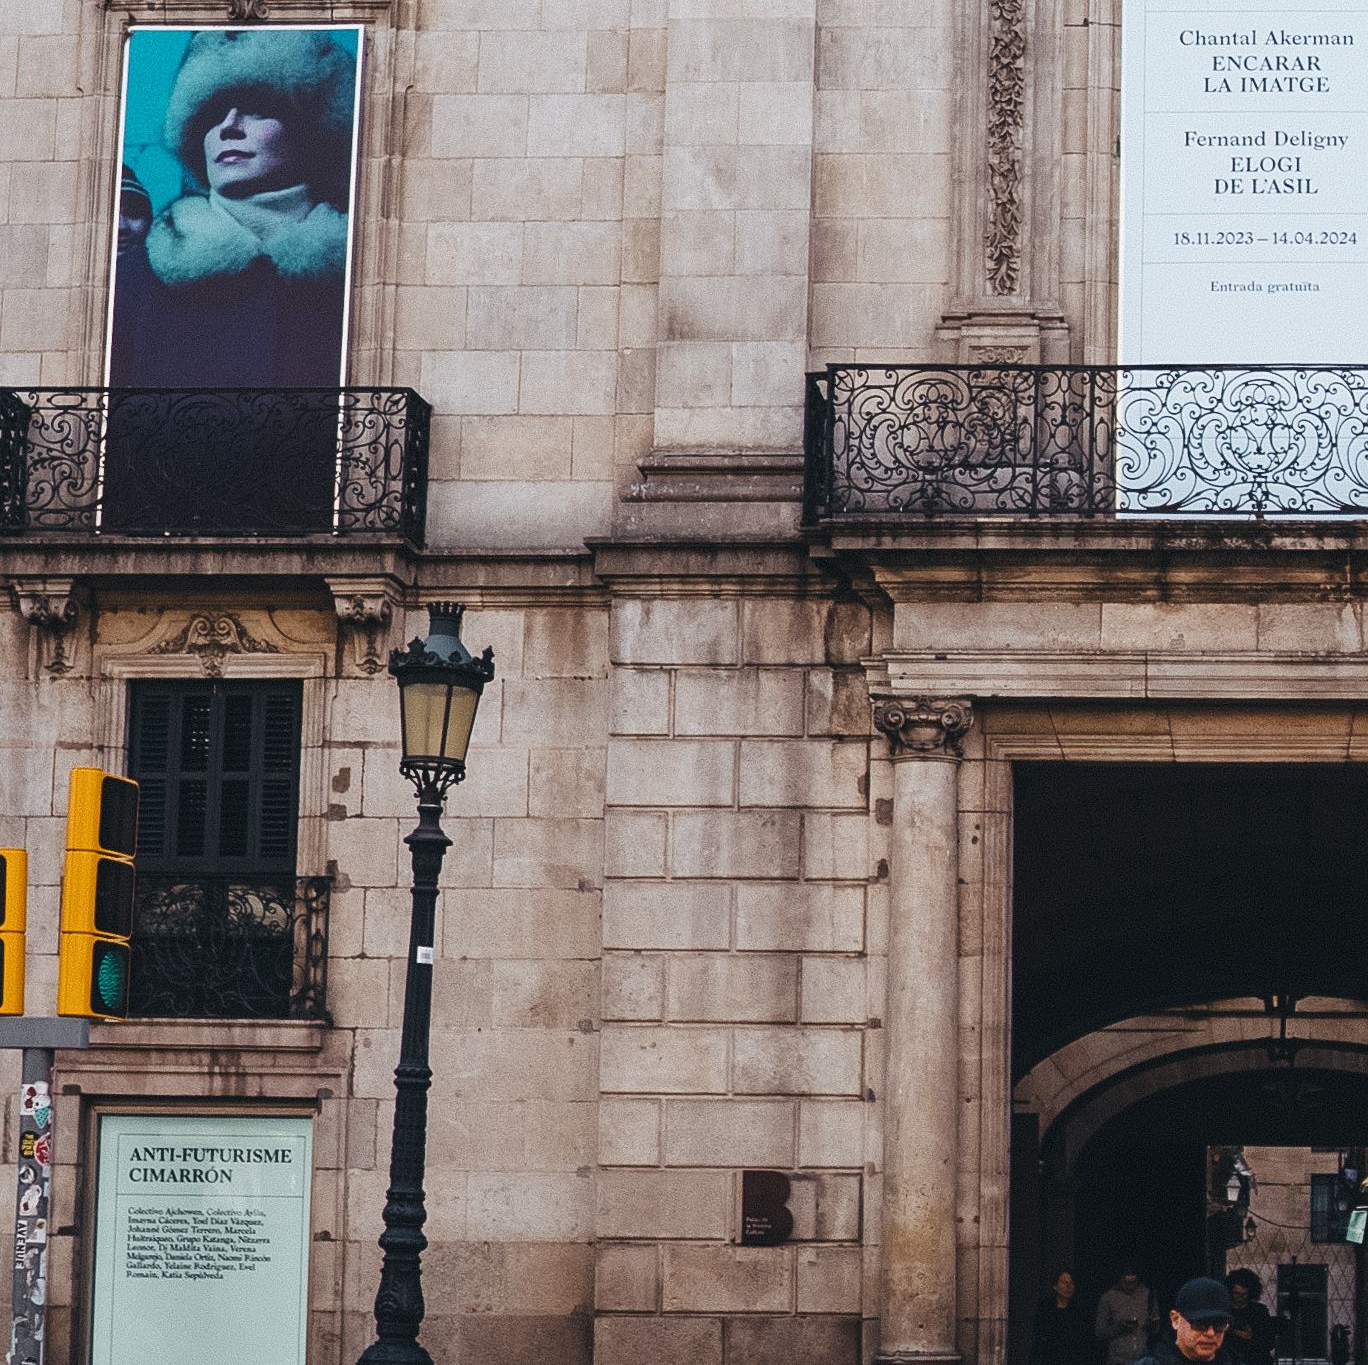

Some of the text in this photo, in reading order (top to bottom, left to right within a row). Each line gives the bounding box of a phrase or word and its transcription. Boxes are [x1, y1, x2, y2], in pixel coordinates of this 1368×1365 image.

[1179, 29, 1354, 46] Chantal Akerman
[1212, 55, 1321, 72] ENCARAR
[1204, 76, 1330, 93] LA IMATGE
[1184, 129, 1349, 150] Fernand Deligny
[1231, 156, 1301, 173] ELOGI
[1215, 178, 1244, 195] DE
[1174, 231, 1254, 246] 18.11.2023
[1273, 231, 1357, 245] 14.04.2024
[1210, 280, 1263, 292] Entrada
[129, 1146, 292, 1164] ANTI-FUTURISME
[128, 1167, 232, 1184] CIMARRÓN
